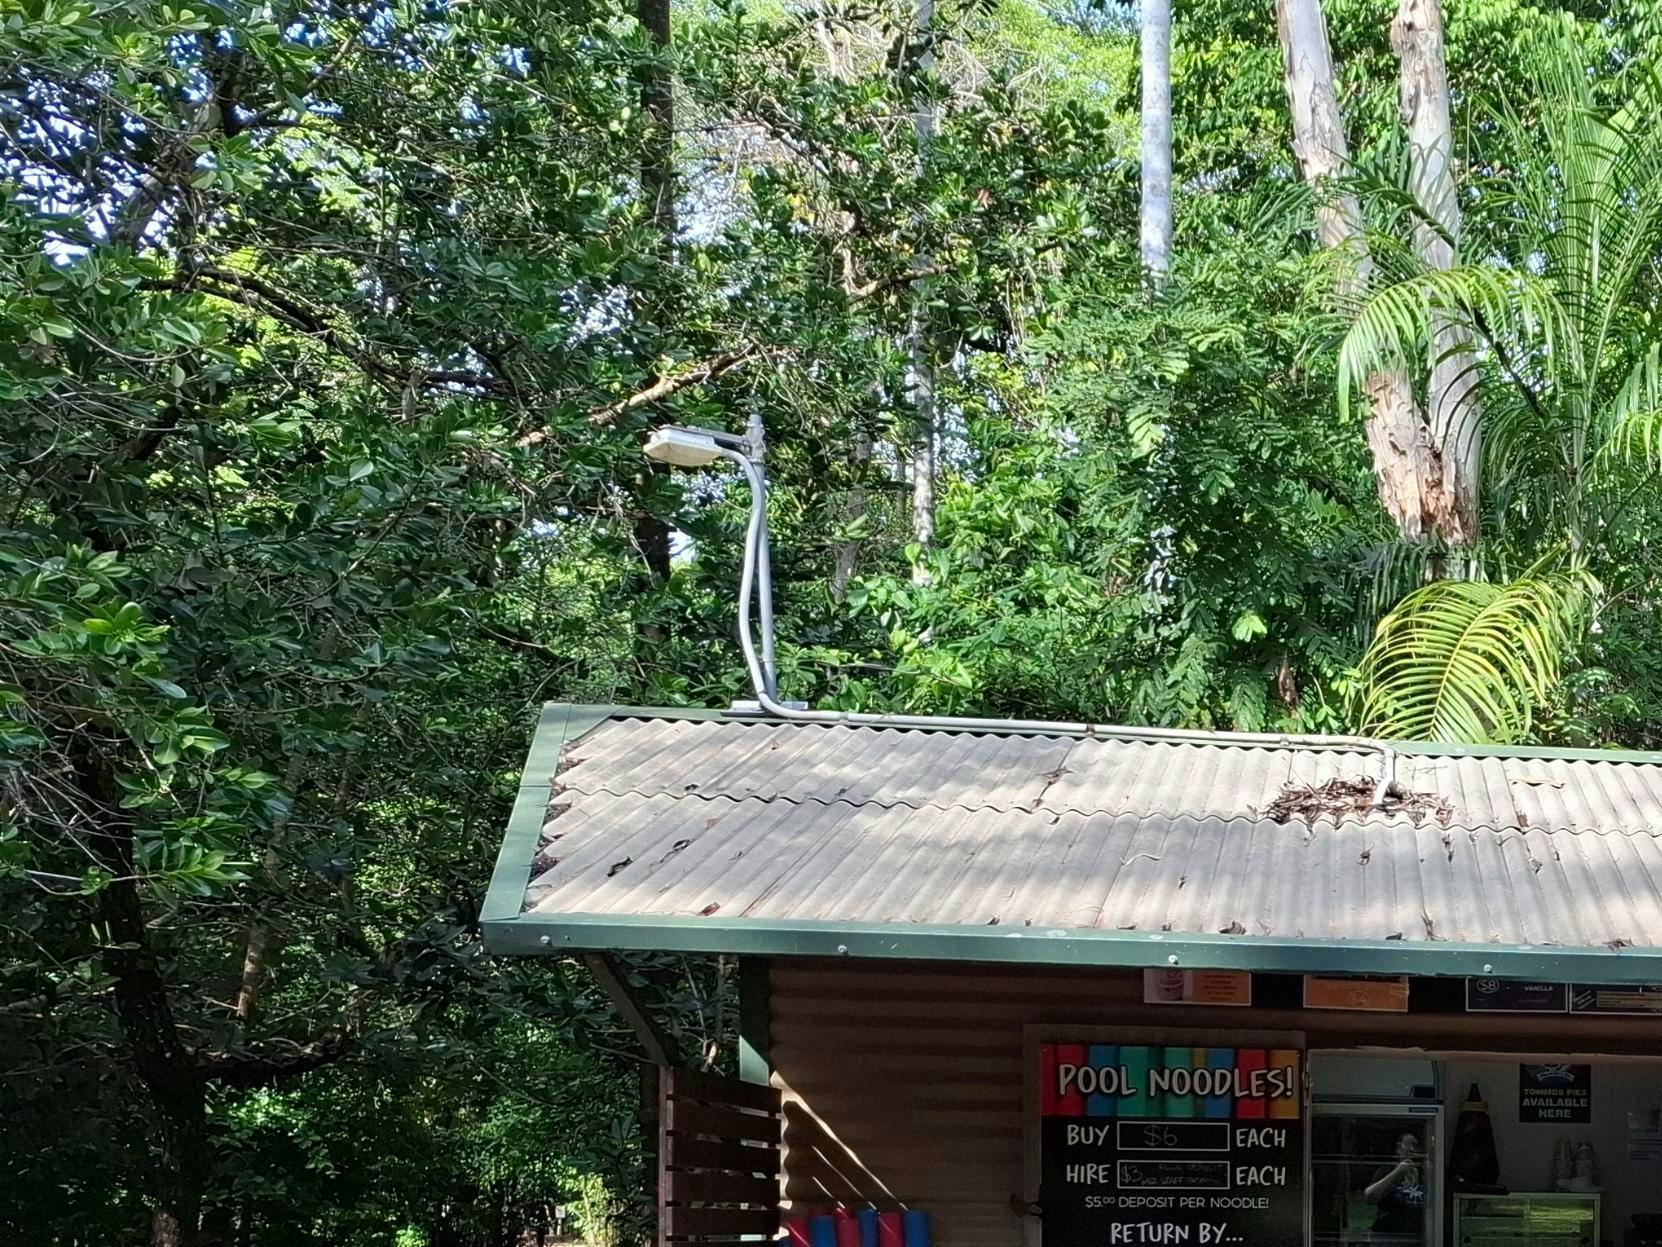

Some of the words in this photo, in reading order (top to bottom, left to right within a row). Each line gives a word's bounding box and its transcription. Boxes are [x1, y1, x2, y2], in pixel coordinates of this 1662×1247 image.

[1058, 1064, 1137, 1096] POOL
[1149, 1067, 1294, 1098] NOODLES!
[1522, 1097, 1589, 1108] AVAILABLE
[1538, 1109, 1572, 1118] HERE
[1067, 1124, 1110, 1146] BUY
[1143, 1125, 1178, 1147] $6
[1236, 1128, 1286, 1148] EACH
[1066, 1163, 1111, 1184] HIRE
[1236, 1165, 1286, 1186] EACH
[1118, 1197, 1174, 1209] DEPOSIT
[1180, 1197, 1205, 1209] PER
[1210, 1198, 1269, 1209] NOODLE!
[1111, 1222, 1189, 1244] RETURN
[1199, 1222, 1244, 1244] BY...
